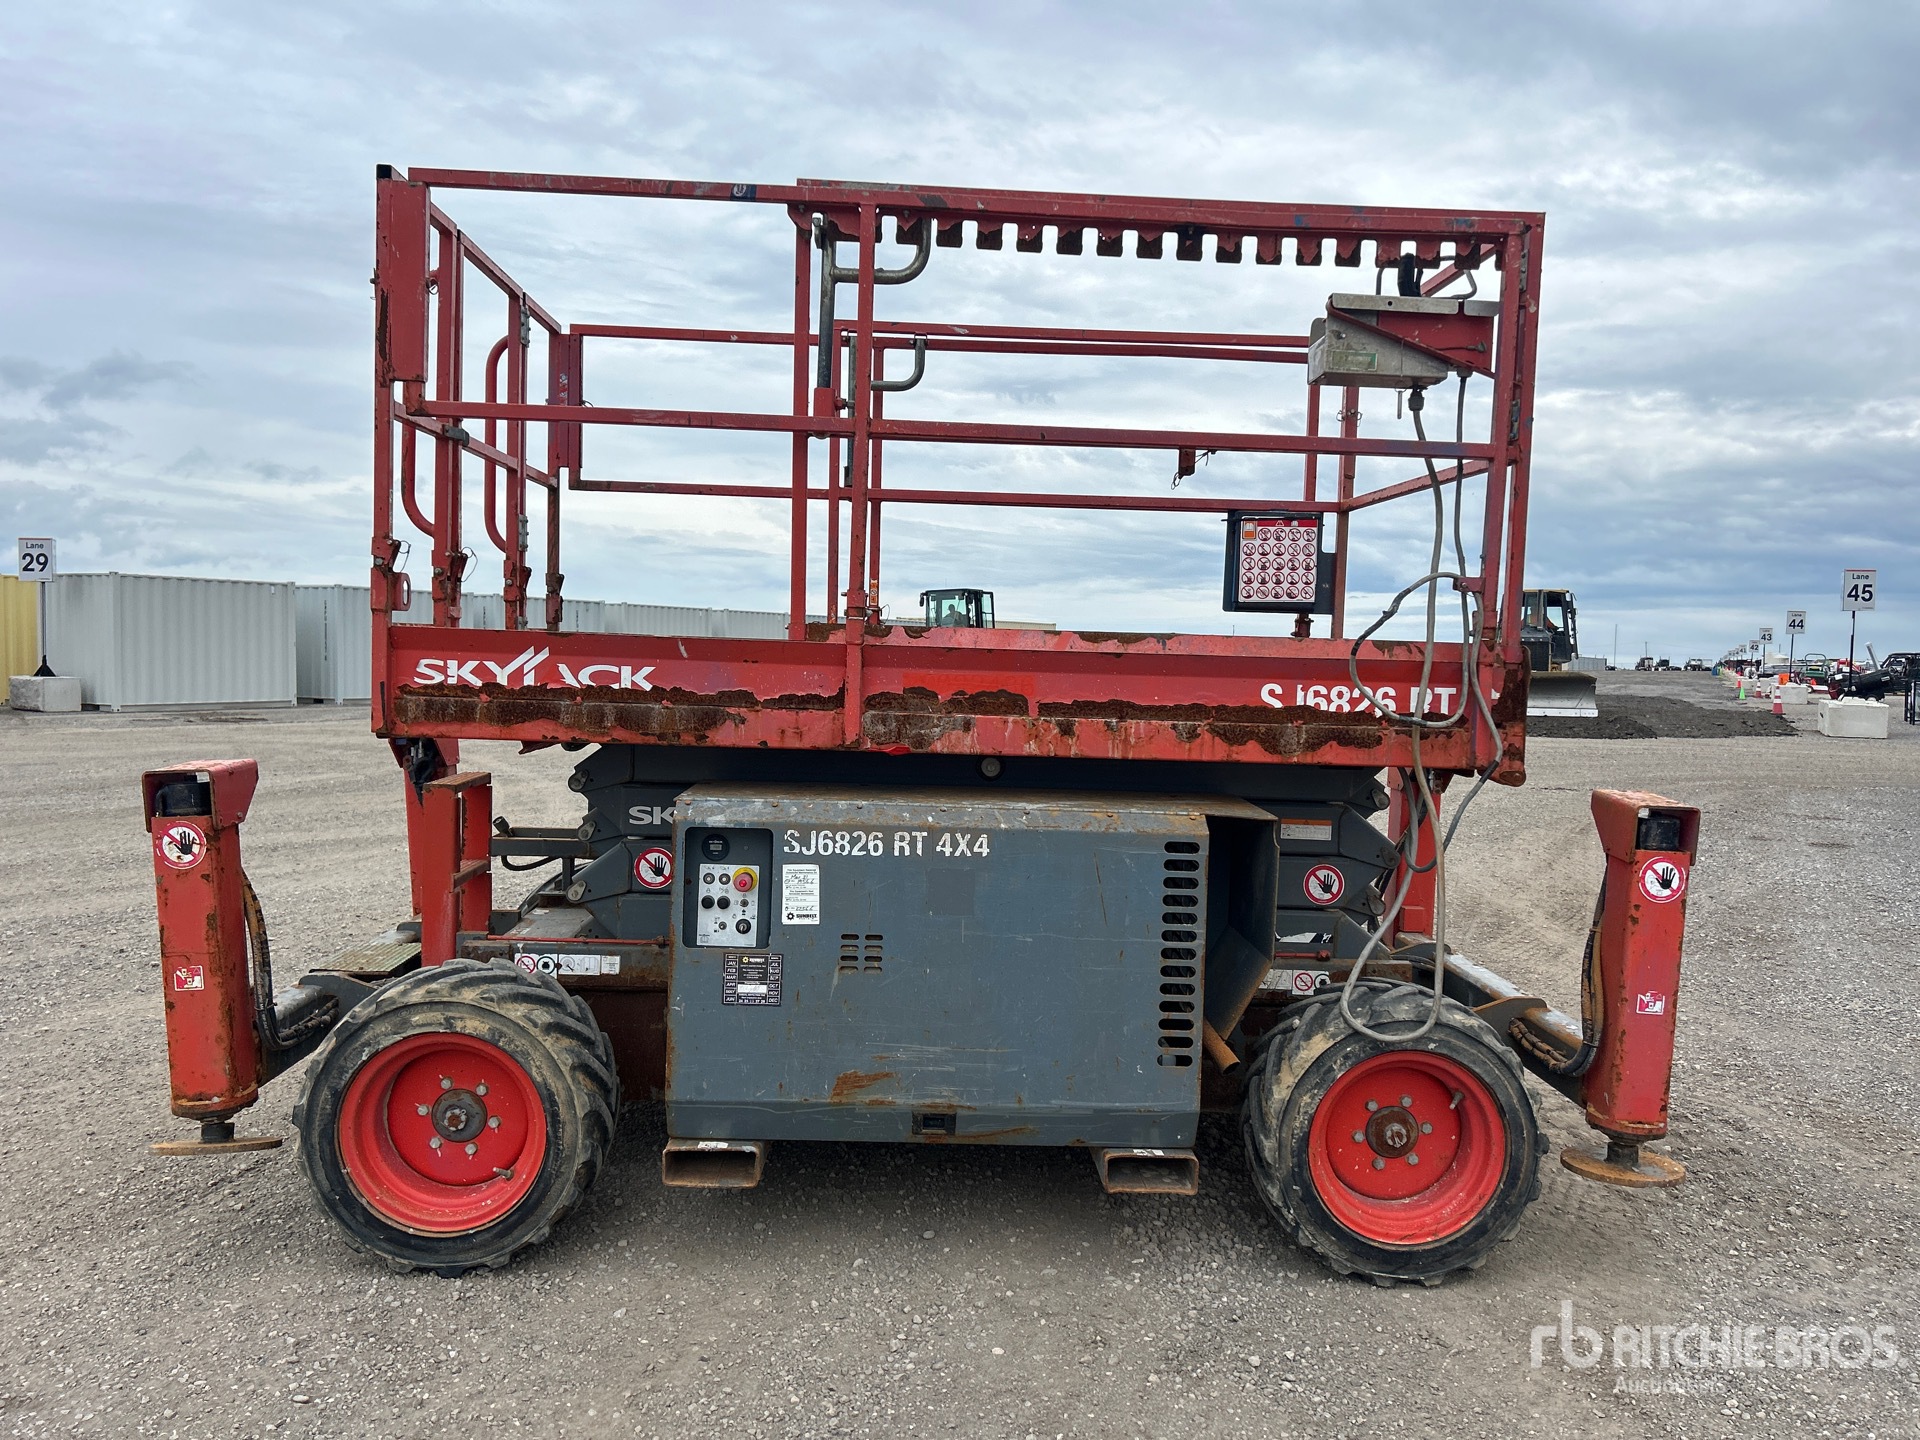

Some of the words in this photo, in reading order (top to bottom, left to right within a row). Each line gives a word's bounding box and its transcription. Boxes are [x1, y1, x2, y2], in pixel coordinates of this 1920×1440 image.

[22, 553, 48, 572] 29
[1847, 584, 1873, 602] 45
[1789, 619, 1804, 629] 44
[783, 829, 884, 857] SJ6826
[893, 831, 928, 857] RT
[935, 832, 990, 857] 4X4
